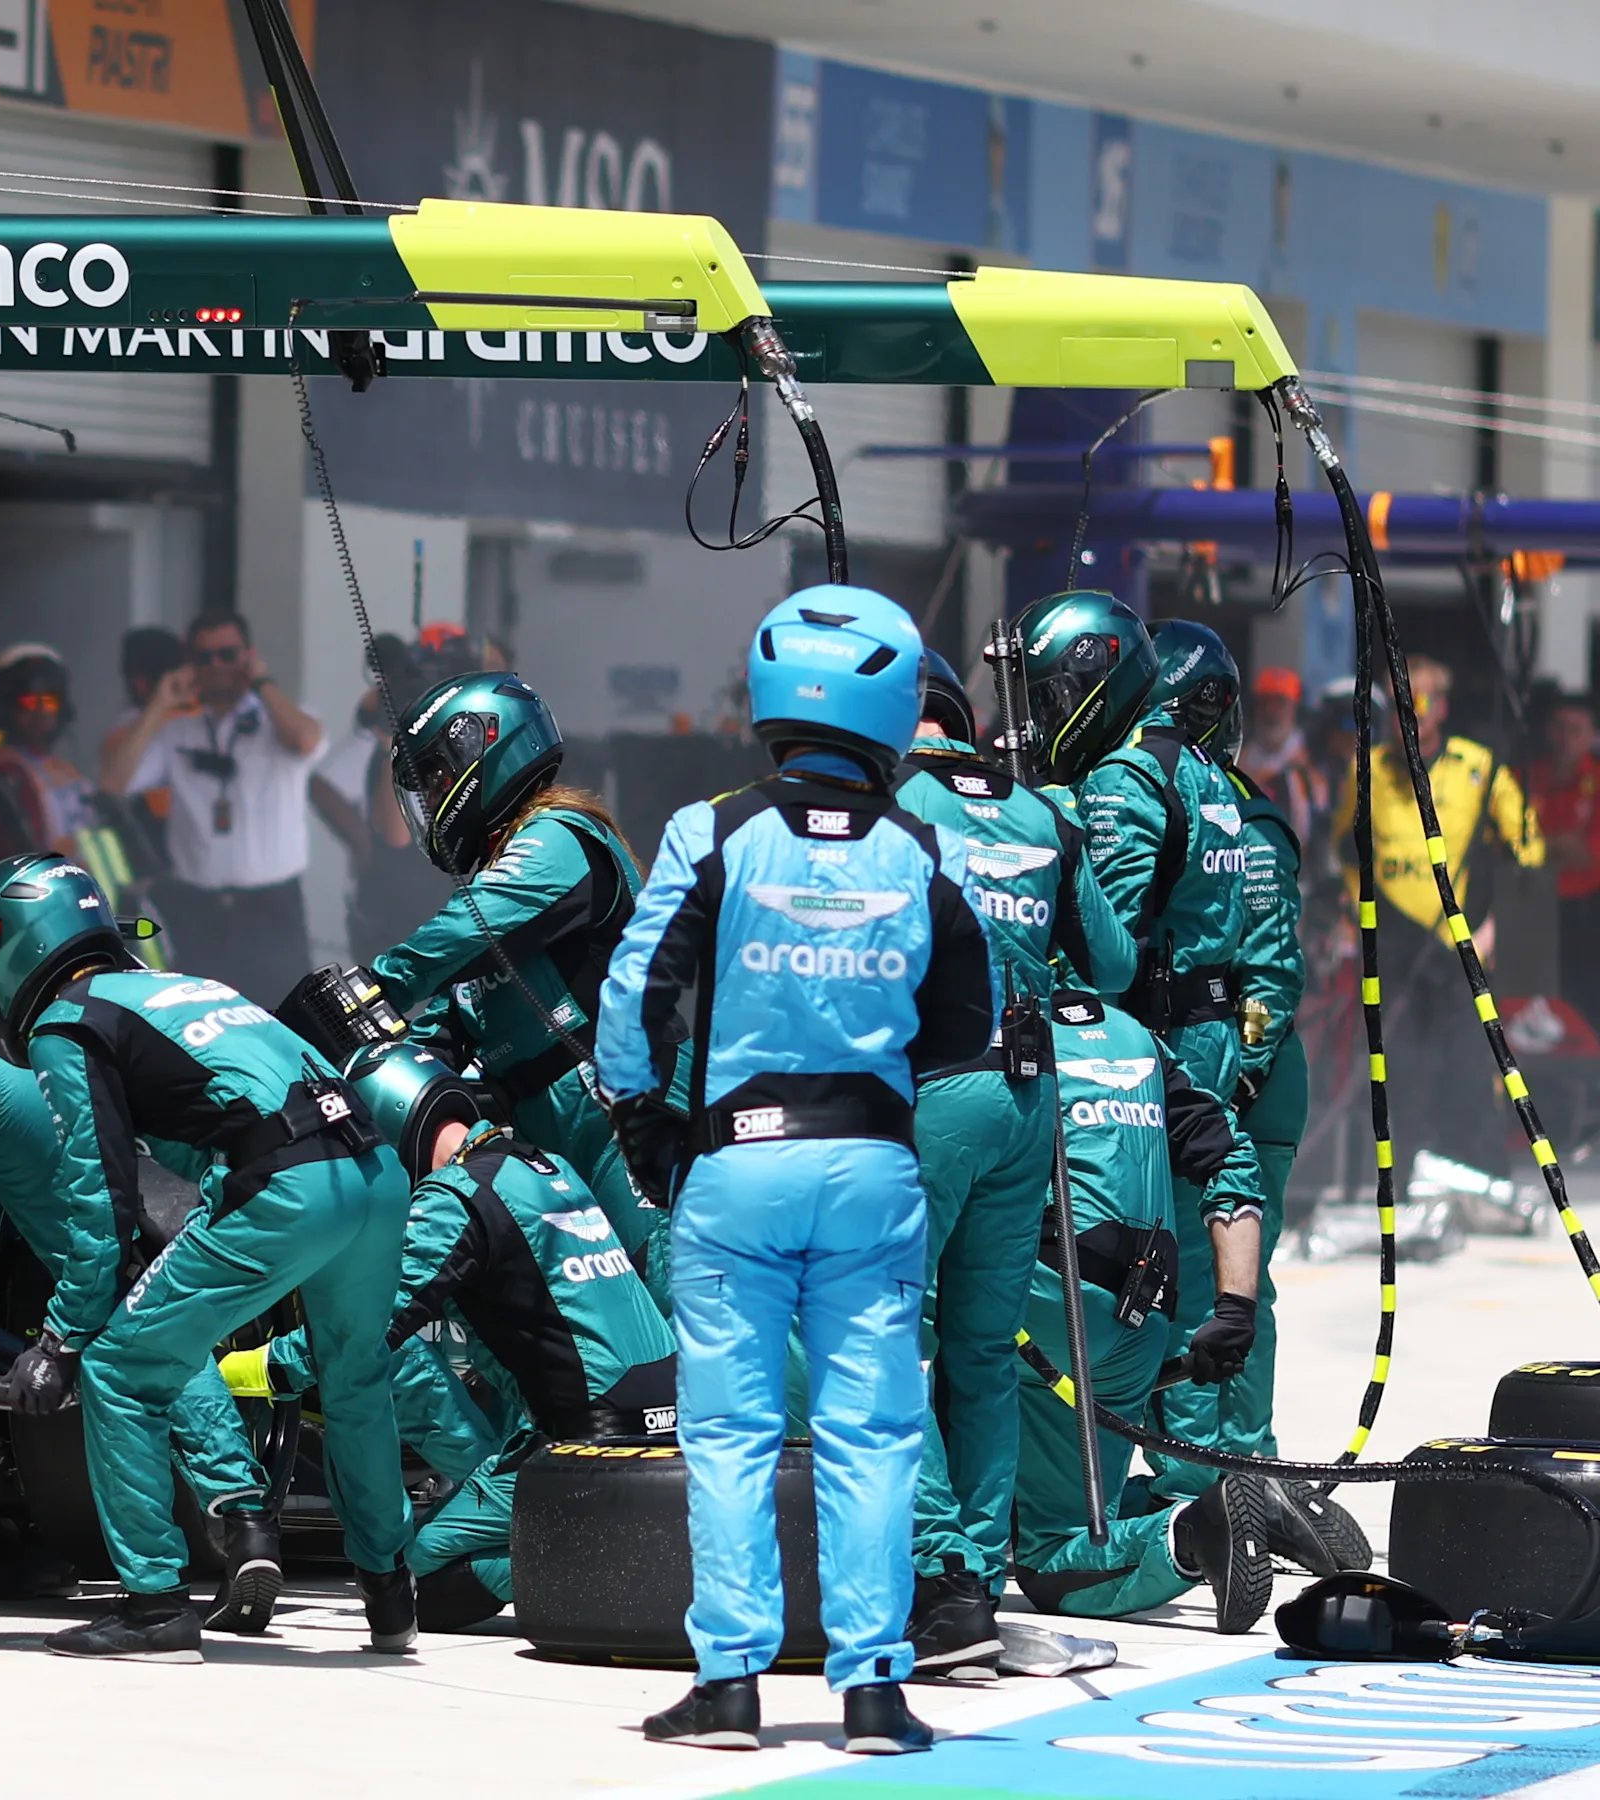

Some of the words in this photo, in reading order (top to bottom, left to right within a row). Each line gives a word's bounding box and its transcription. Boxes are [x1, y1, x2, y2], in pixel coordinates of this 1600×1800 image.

[782, 636, 858, 660] cognizant
[1060, 723, 1084, 752] ASTON
[1081, 698, 1105, 731] MARTIN
[455, 777, 480, 811] MARTIN
[954, 778, 988, 793] OMP
[807, 811, 850, 833] OMP
[1202, 848, 1246, 874] aram
[791, 896, 824, 910] ASTON
[824, 897, 864, 911] MARTIN
[973, 886, 1049, 927] amco
[741, 941, 907, 980] aramco
[183, 1004, 279, 1048] aram
[553, 1005, 573, 1024] MP
[319, 1094, 350, 1118] OM
[1071, 1099, 1164, 1129] aramco
[733, 1110, 785, 1136] OMP
[562, 1249, 631, 1283] aram
[644, 1408, 677, 1431] OMP
